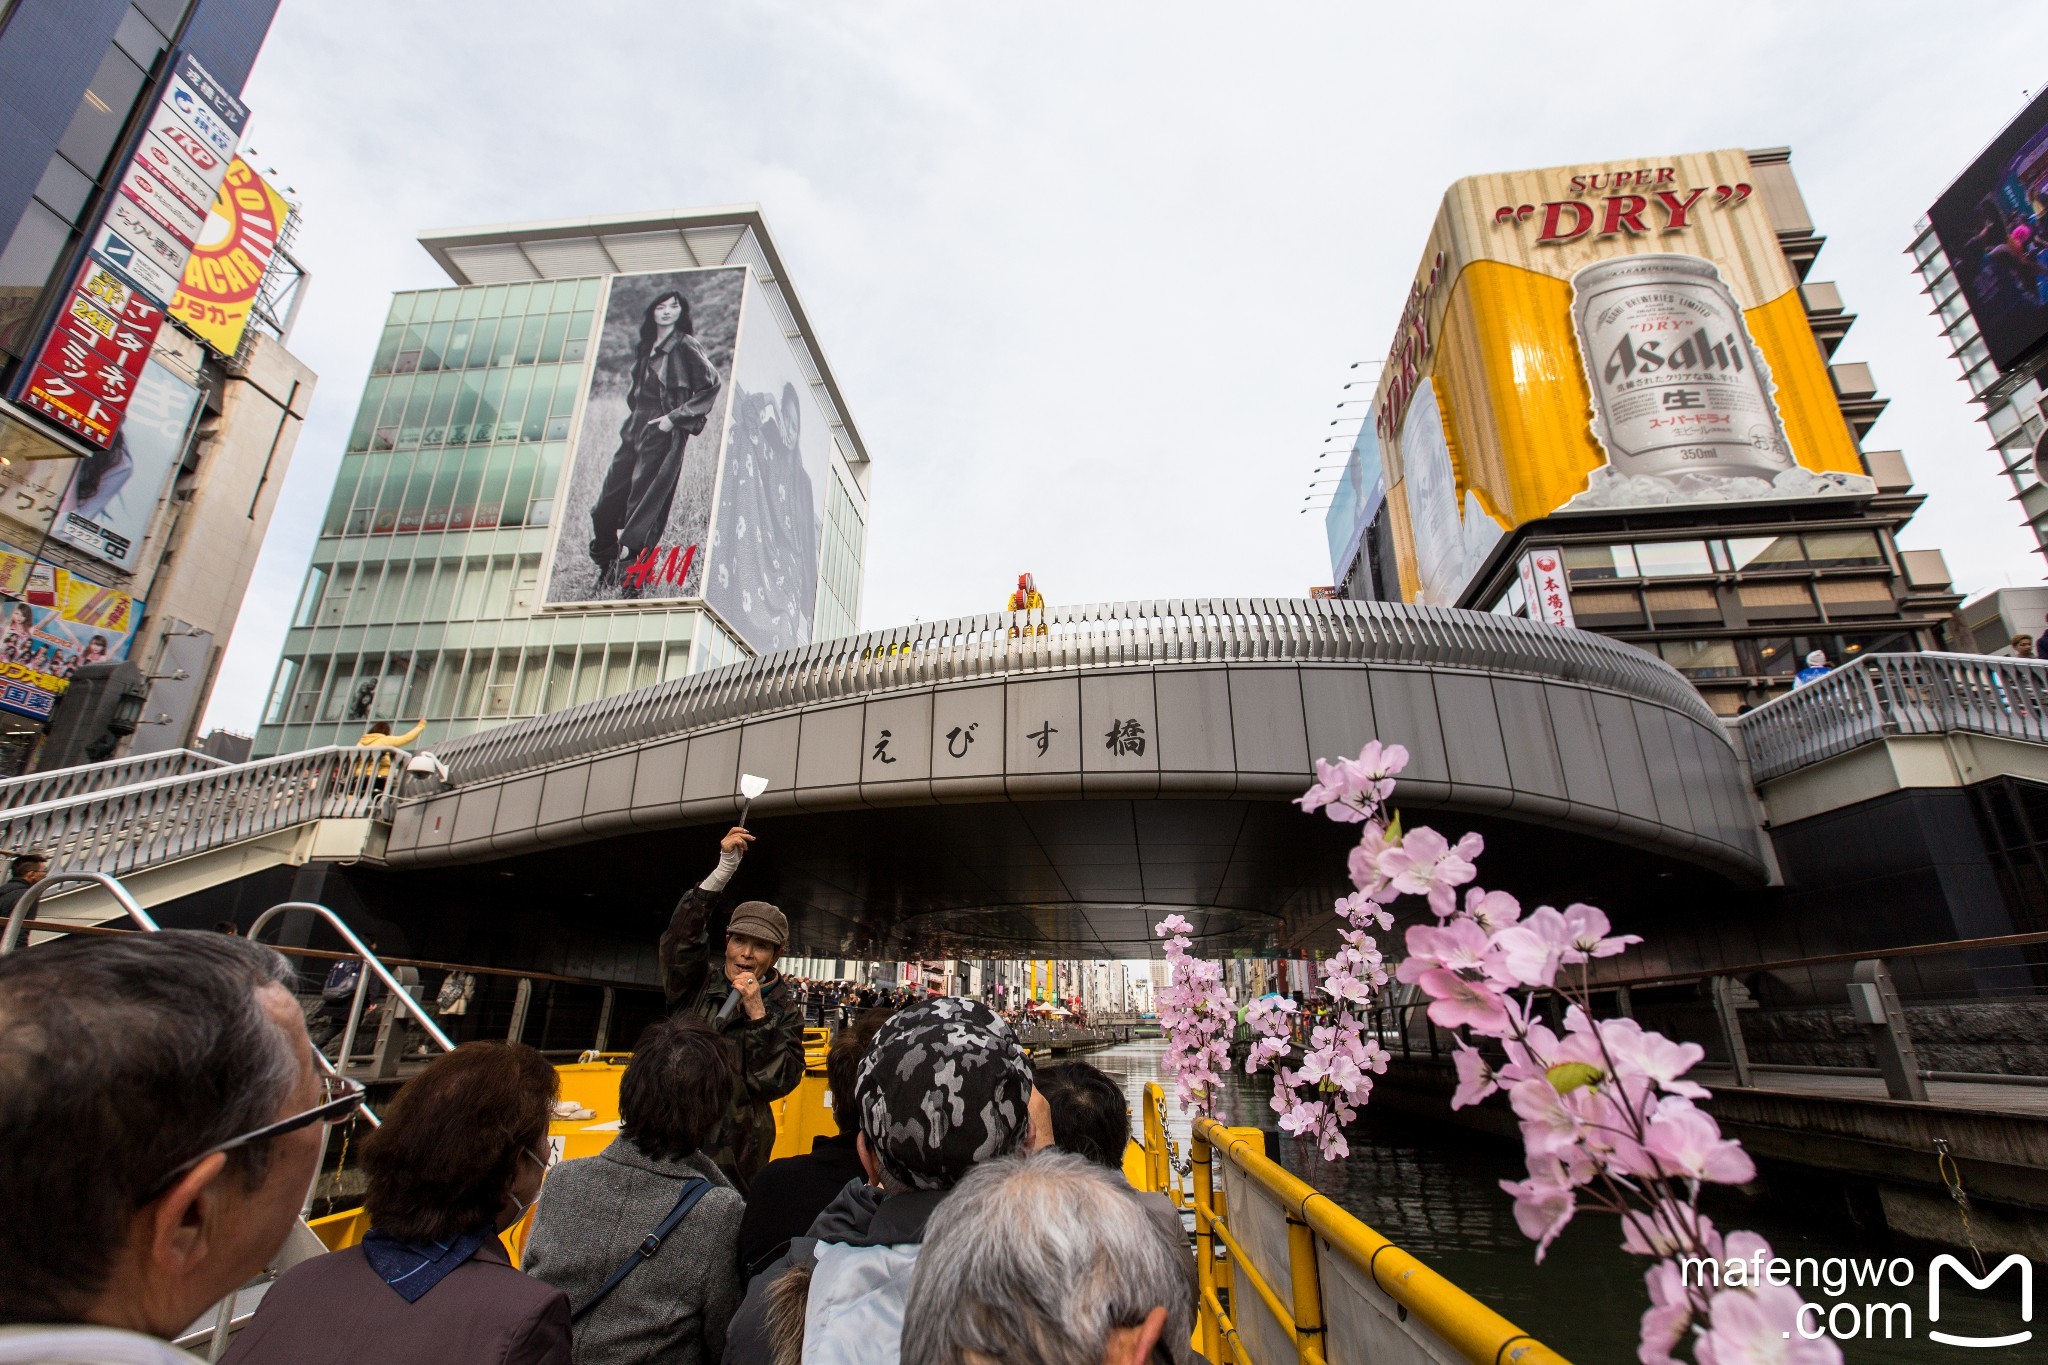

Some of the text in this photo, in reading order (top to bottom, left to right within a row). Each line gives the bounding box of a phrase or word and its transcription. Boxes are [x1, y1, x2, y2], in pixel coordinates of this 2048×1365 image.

[167, 128, 216, 167] TKP
[1569, 167, 1676, 194] SUPER
[73, 300, 115, 337] 24H
[44, 319, 100, 397] コミック
[87, 299, 159, 423] インターネット
[1604, 327, 1744, 386] Asahi
[1662, 389, 1706, 411] 生
[1649, 414, 1731, 430] スーパードライ
[1681, 448, 1718, 461] 350ml
[622, 544, 698, 590] H&M
[869, 718, 1148, 764] えびす橋
